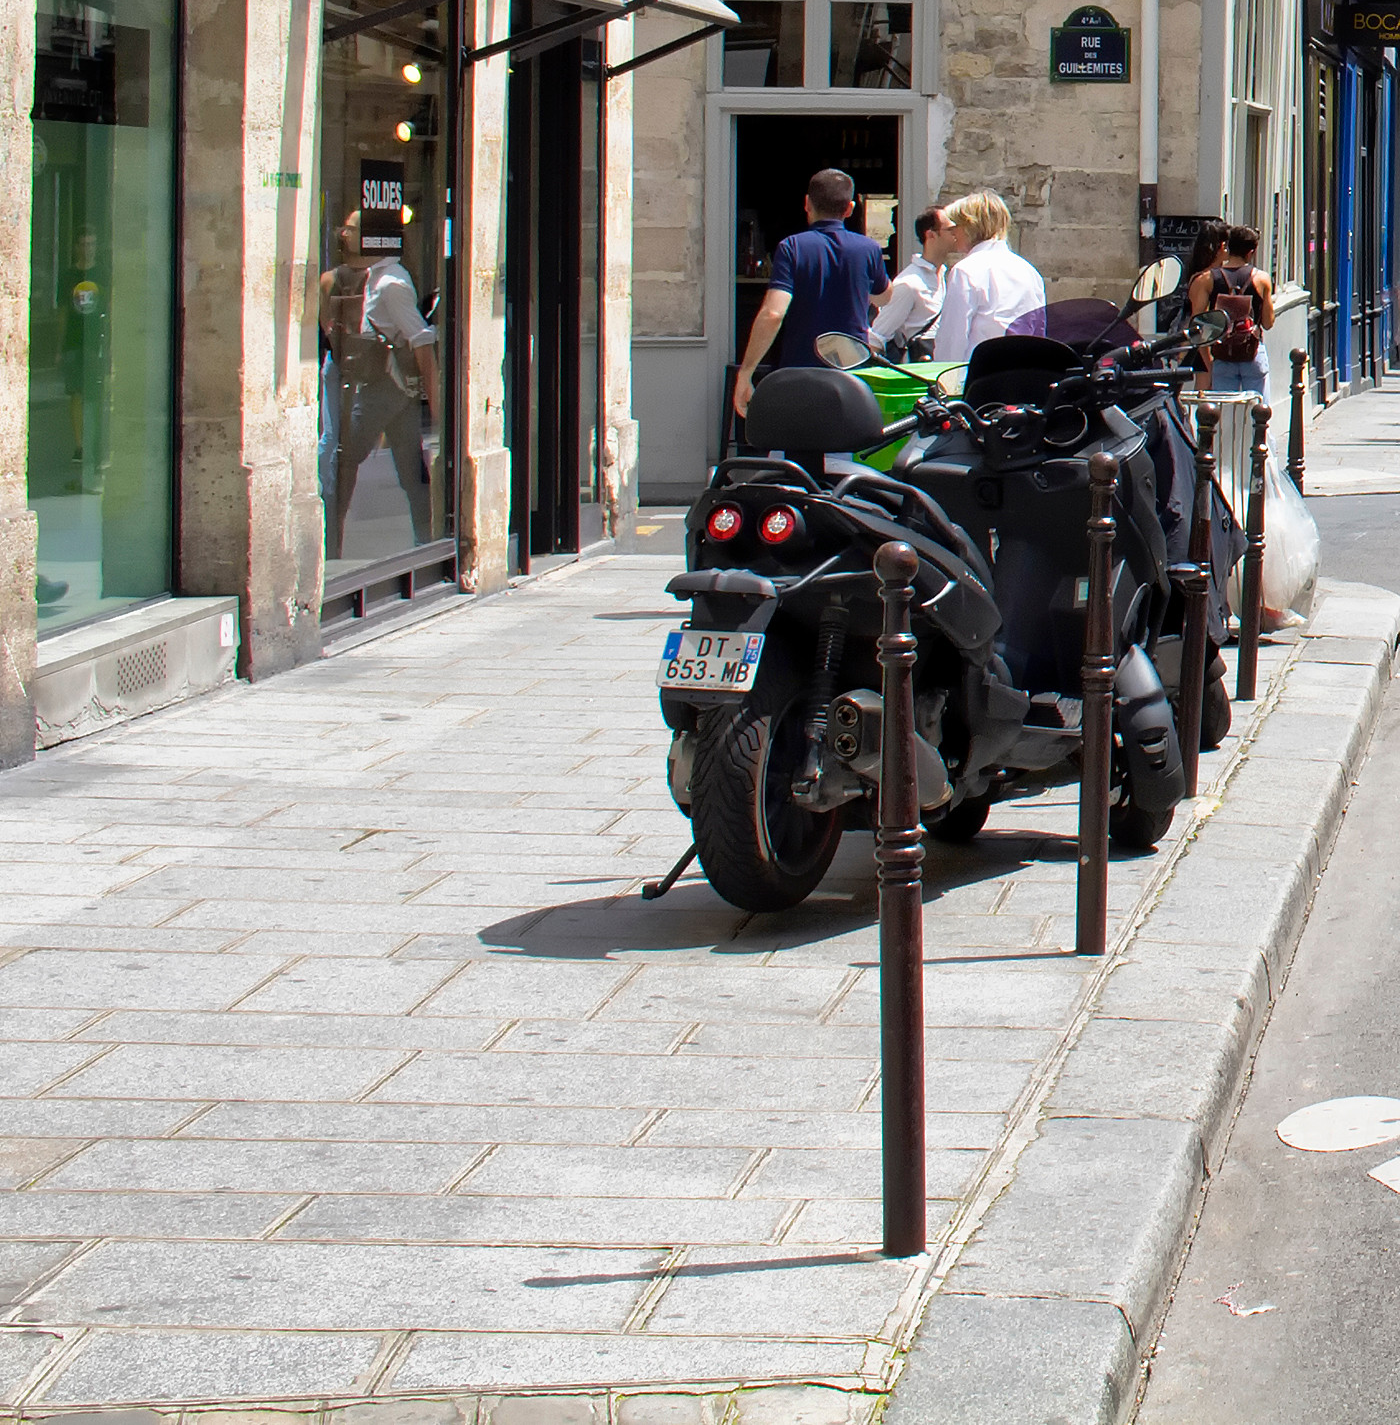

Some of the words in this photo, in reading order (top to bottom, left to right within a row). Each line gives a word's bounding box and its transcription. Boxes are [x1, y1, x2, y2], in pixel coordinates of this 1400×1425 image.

[1081, 37, 1101, 48] RUE
[1058, 62, 1123, 74] GUILLEMITES
[362, 179, 403, 211] SOLDES
[745, 649, 758, 661] 75
